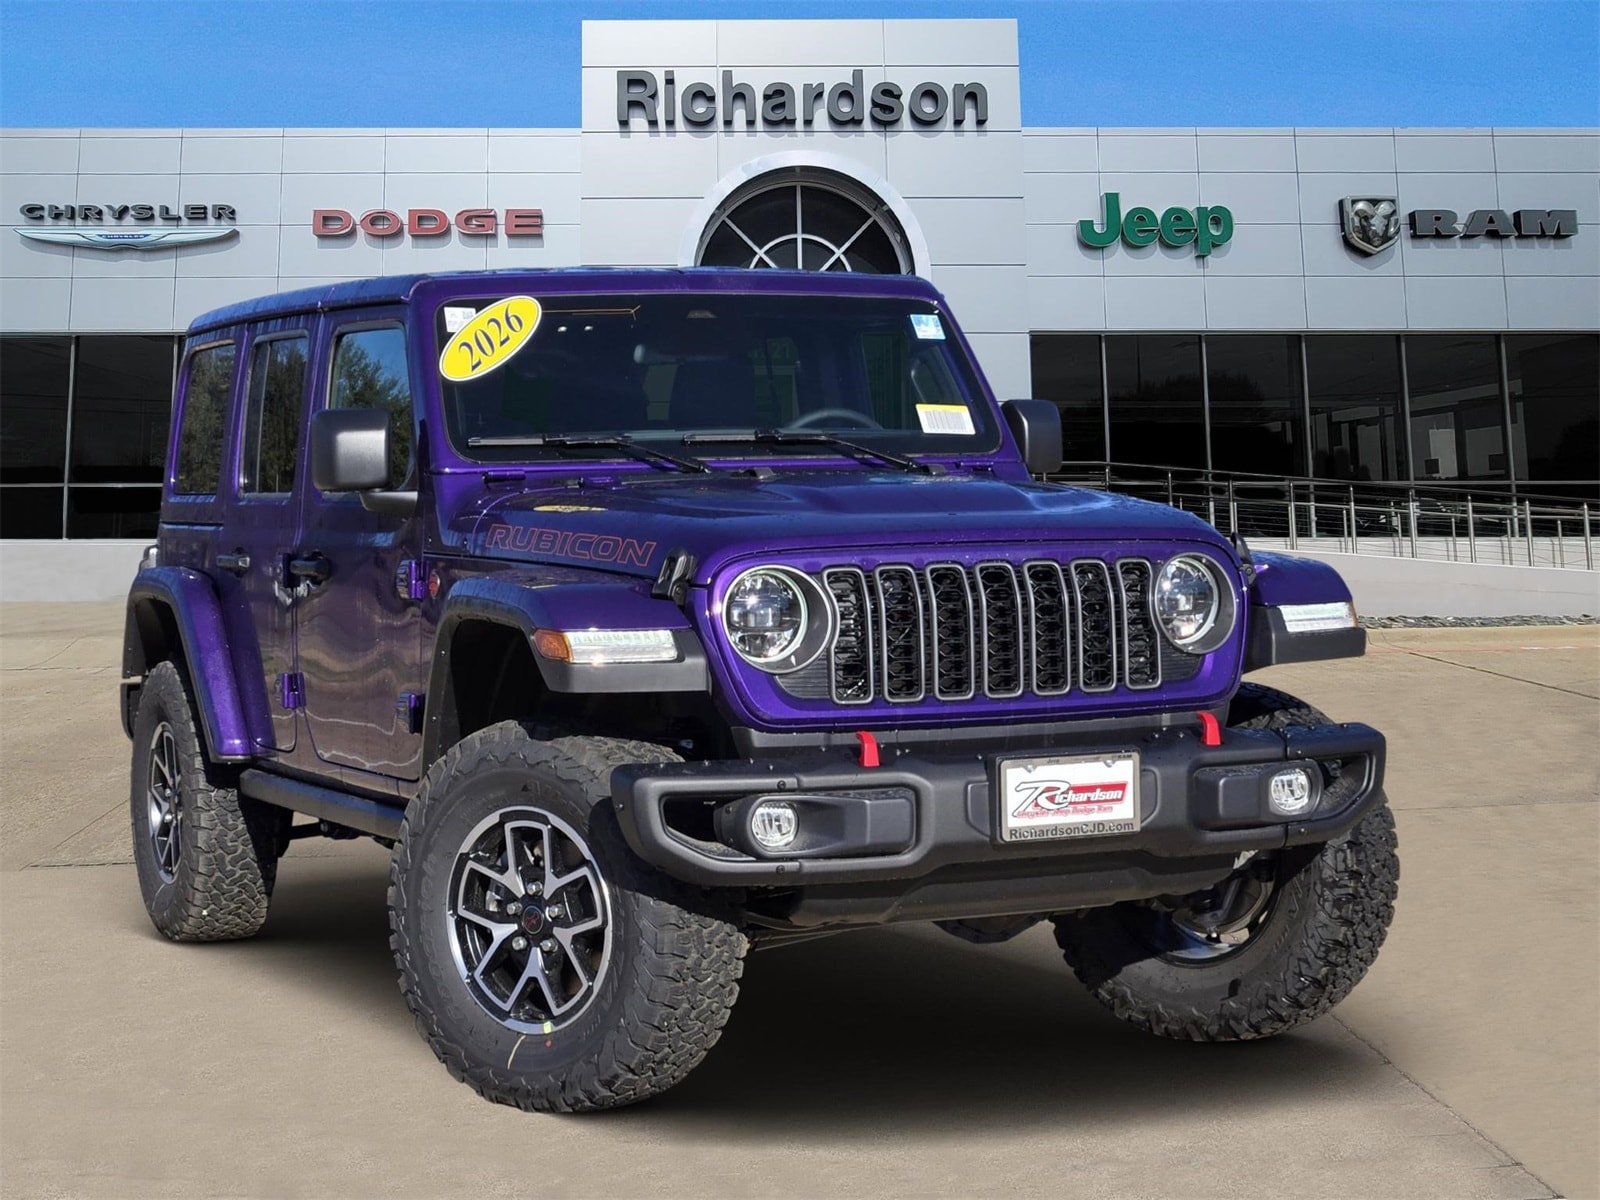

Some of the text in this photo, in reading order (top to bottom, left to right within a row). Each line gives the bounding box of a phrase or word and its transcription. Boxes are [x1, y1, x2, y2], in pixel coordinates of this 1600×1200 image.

[616, 69, 989, 126] Richardson
[19, 202, 237, 222] CHRYSLER
[312, 207, 544, 236] DODGE
[1077, 192, 1235, 258] Jeep
[1408, 208, 1579, 239] RAM
[458, 303, 524, 372] 2026
[485, 523, 657, 568] RUBICON
[1012, 779, 1122, 817] Richardson
[1009, 821, 1134, 839] RichardsonCJD.com
